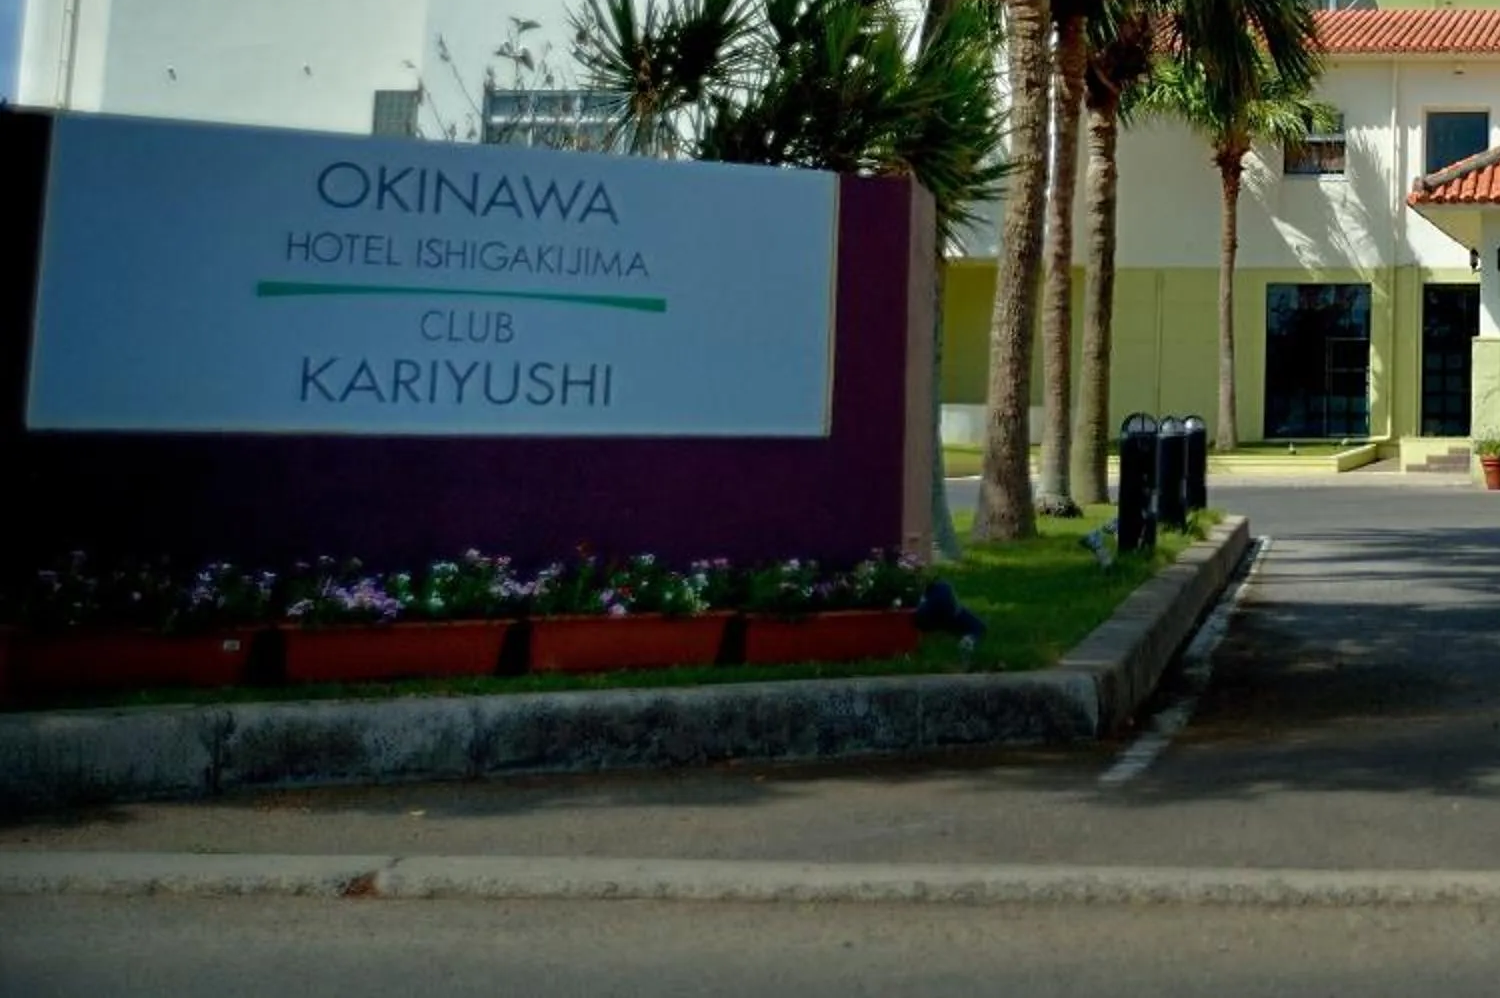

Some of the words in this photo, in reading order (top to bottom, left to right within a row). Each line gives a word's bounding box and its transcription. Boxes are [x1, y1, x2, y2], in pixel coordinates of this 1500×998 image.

[316, 161, 620, 225] OKINAWA
[286, 231, 401, 266] HOTEL
[415, 237, 650, 278] ISHIGAKIJIMA
[420, 310, 514, 344] CLUB
[299, 356, 613, 407] KARIYUSHI
